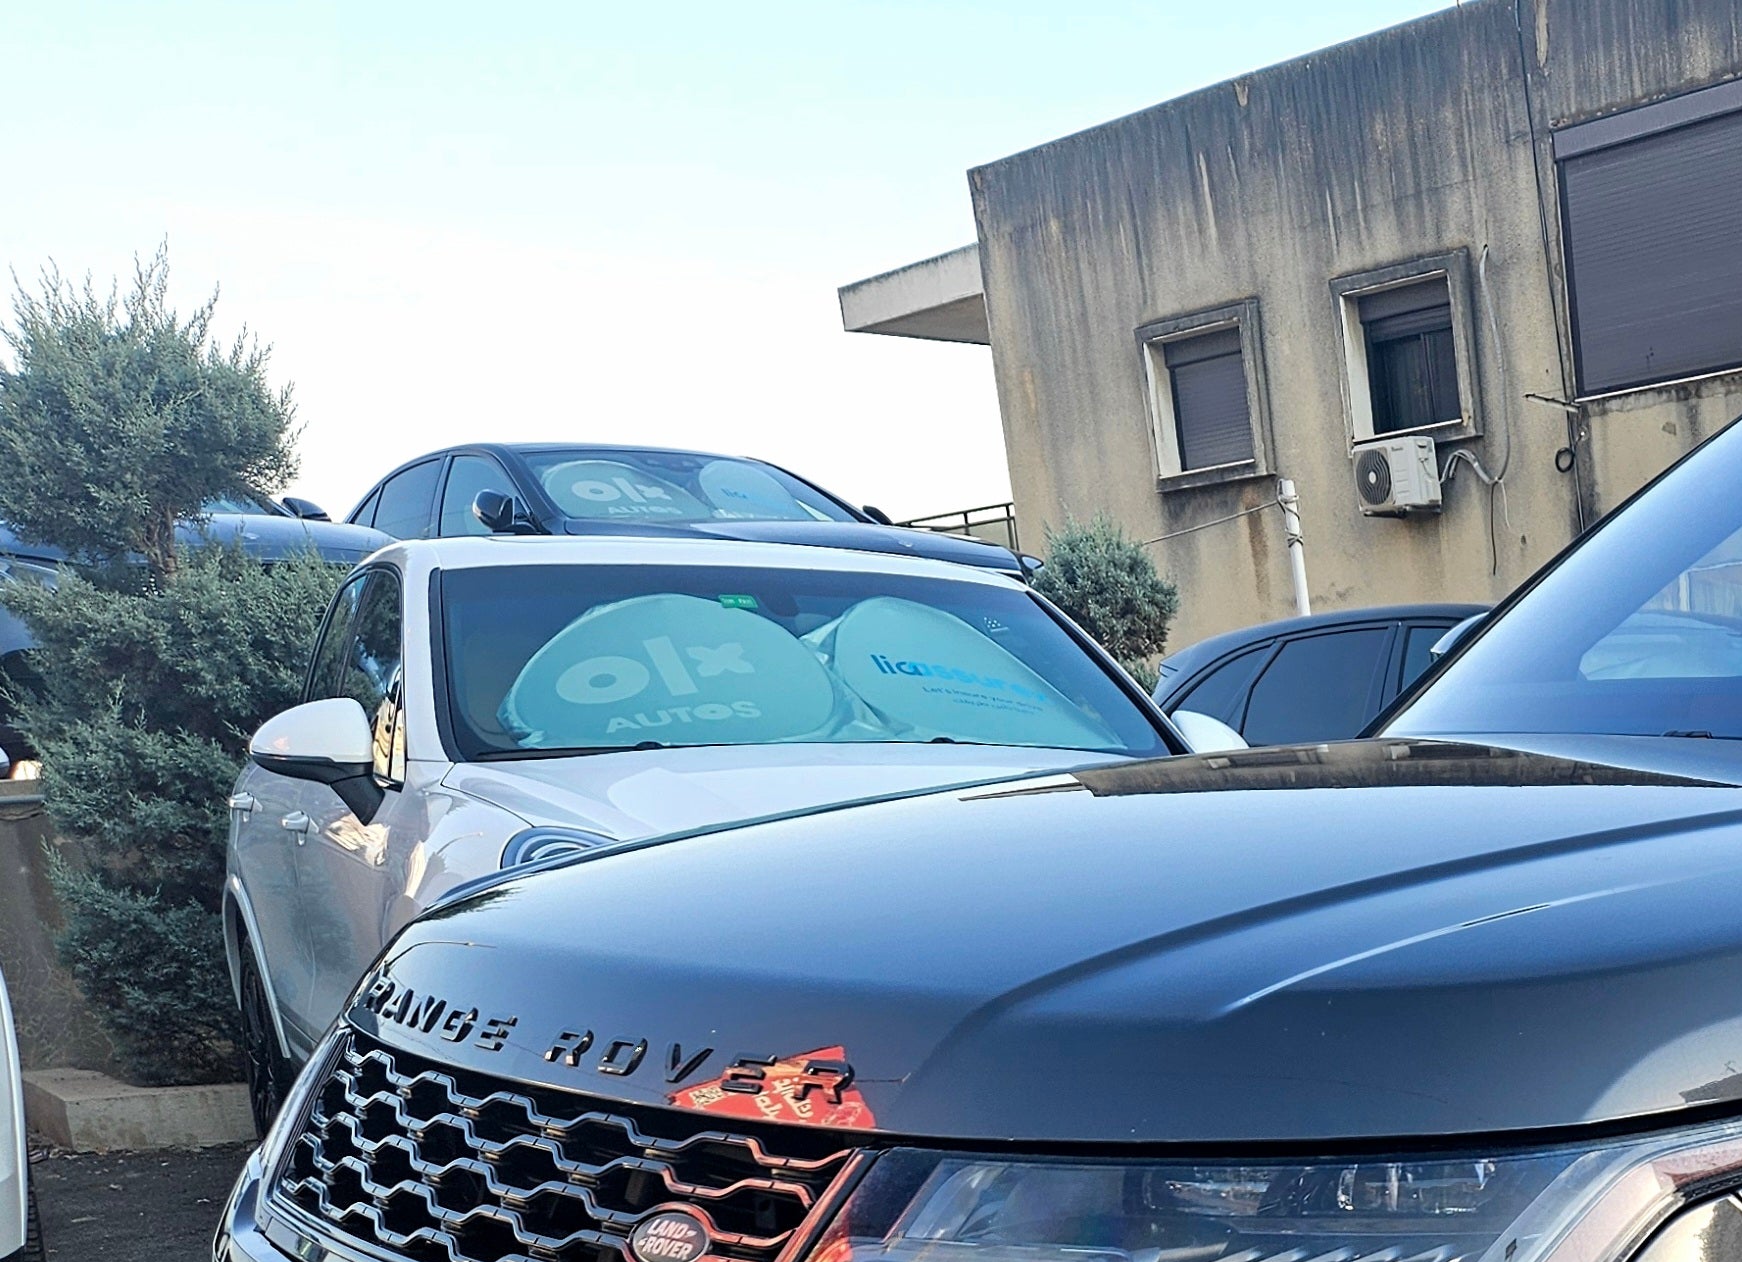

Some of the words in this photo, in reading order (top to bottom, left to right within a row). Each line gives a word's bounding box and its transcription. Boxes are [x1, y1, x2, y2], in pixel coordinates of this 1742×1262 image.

[571, 477, 673, 503] olx
[556, 635, 756, 706] olx
[605, 701, 762, 734] AUTOS
[362, 974, 519, 1052] RANGE
[544, 1026, 855, 1104] ROVER
[647, 1218, 690, 1238] LAND
[641, 1236, 693, 1260] ROVER
